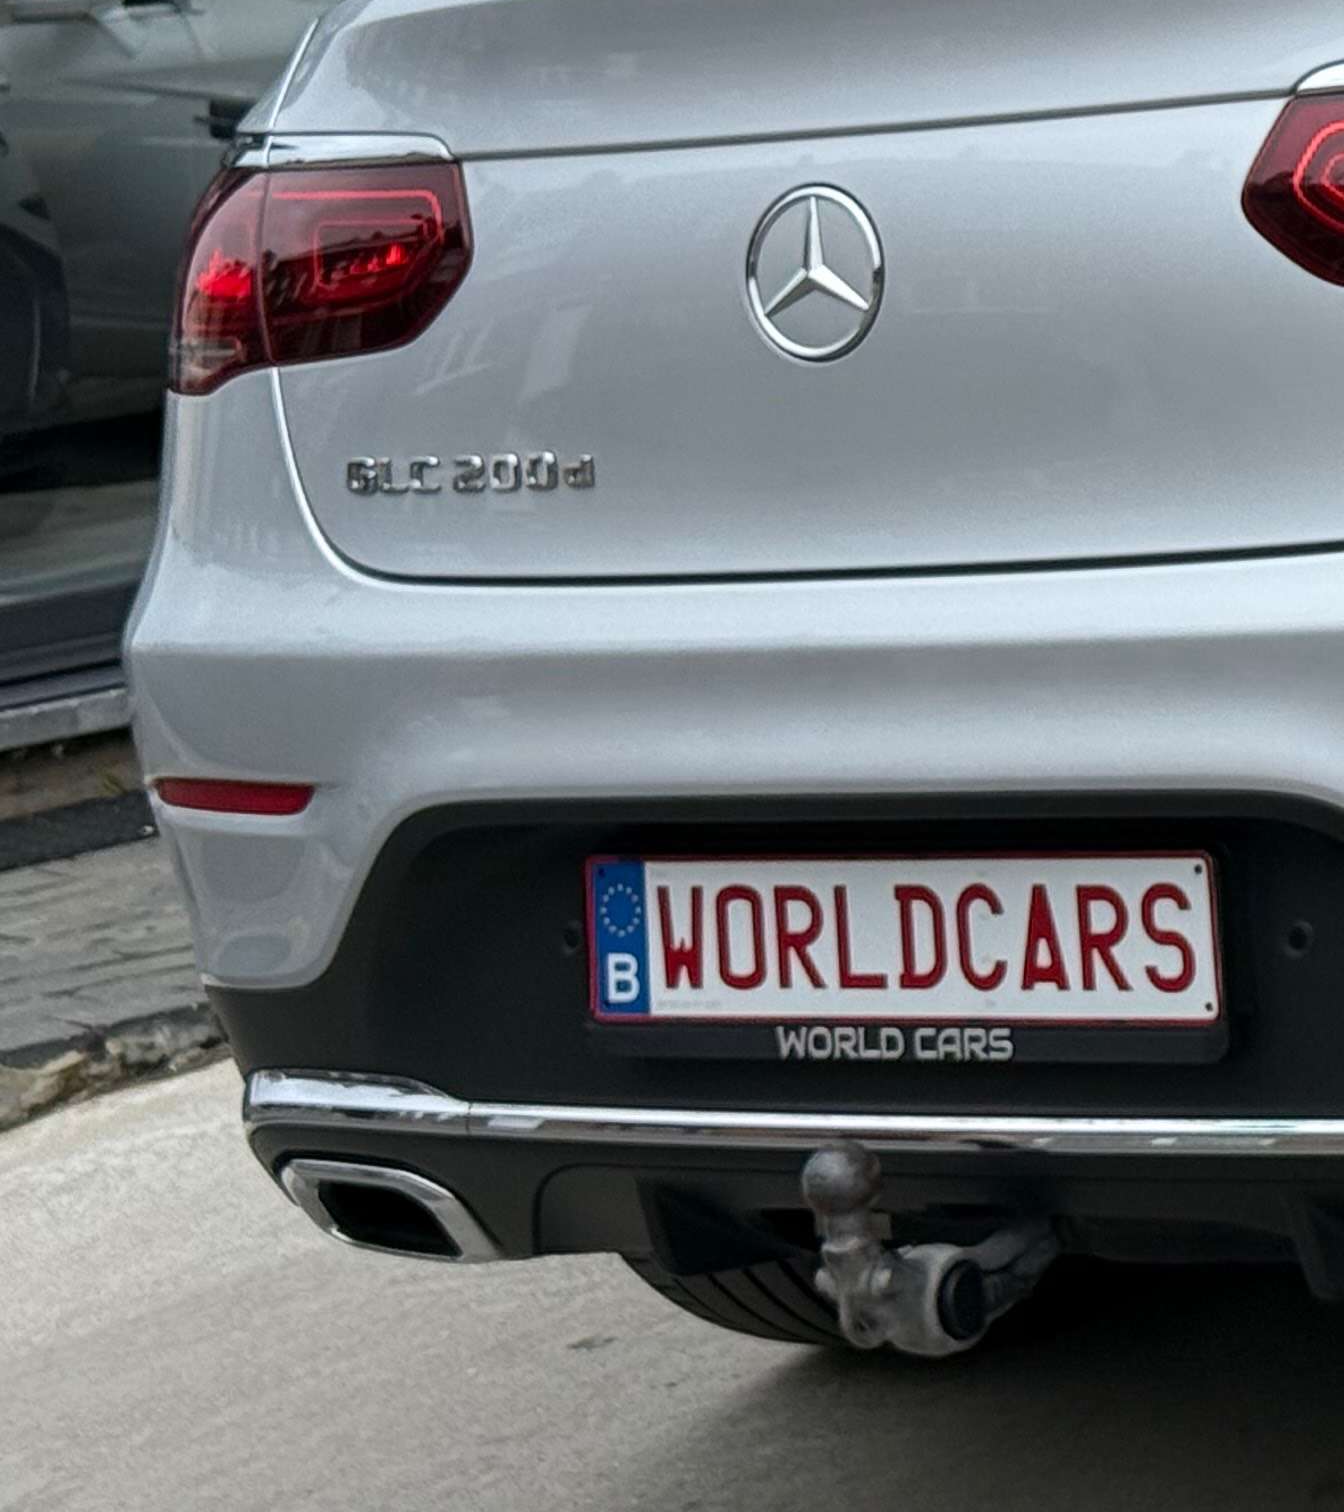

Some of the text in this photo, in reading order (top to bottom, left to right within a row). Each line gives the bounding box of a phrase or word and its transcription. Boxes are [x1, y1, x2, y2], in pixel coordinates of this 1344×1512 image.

[347, 456, 442, 495] GLC
[656, 882, 1196, 993] WORLDCARS
[606, 953, 640, 1004] B
[776, 1026, 1015, 1061] WORLD CARS
